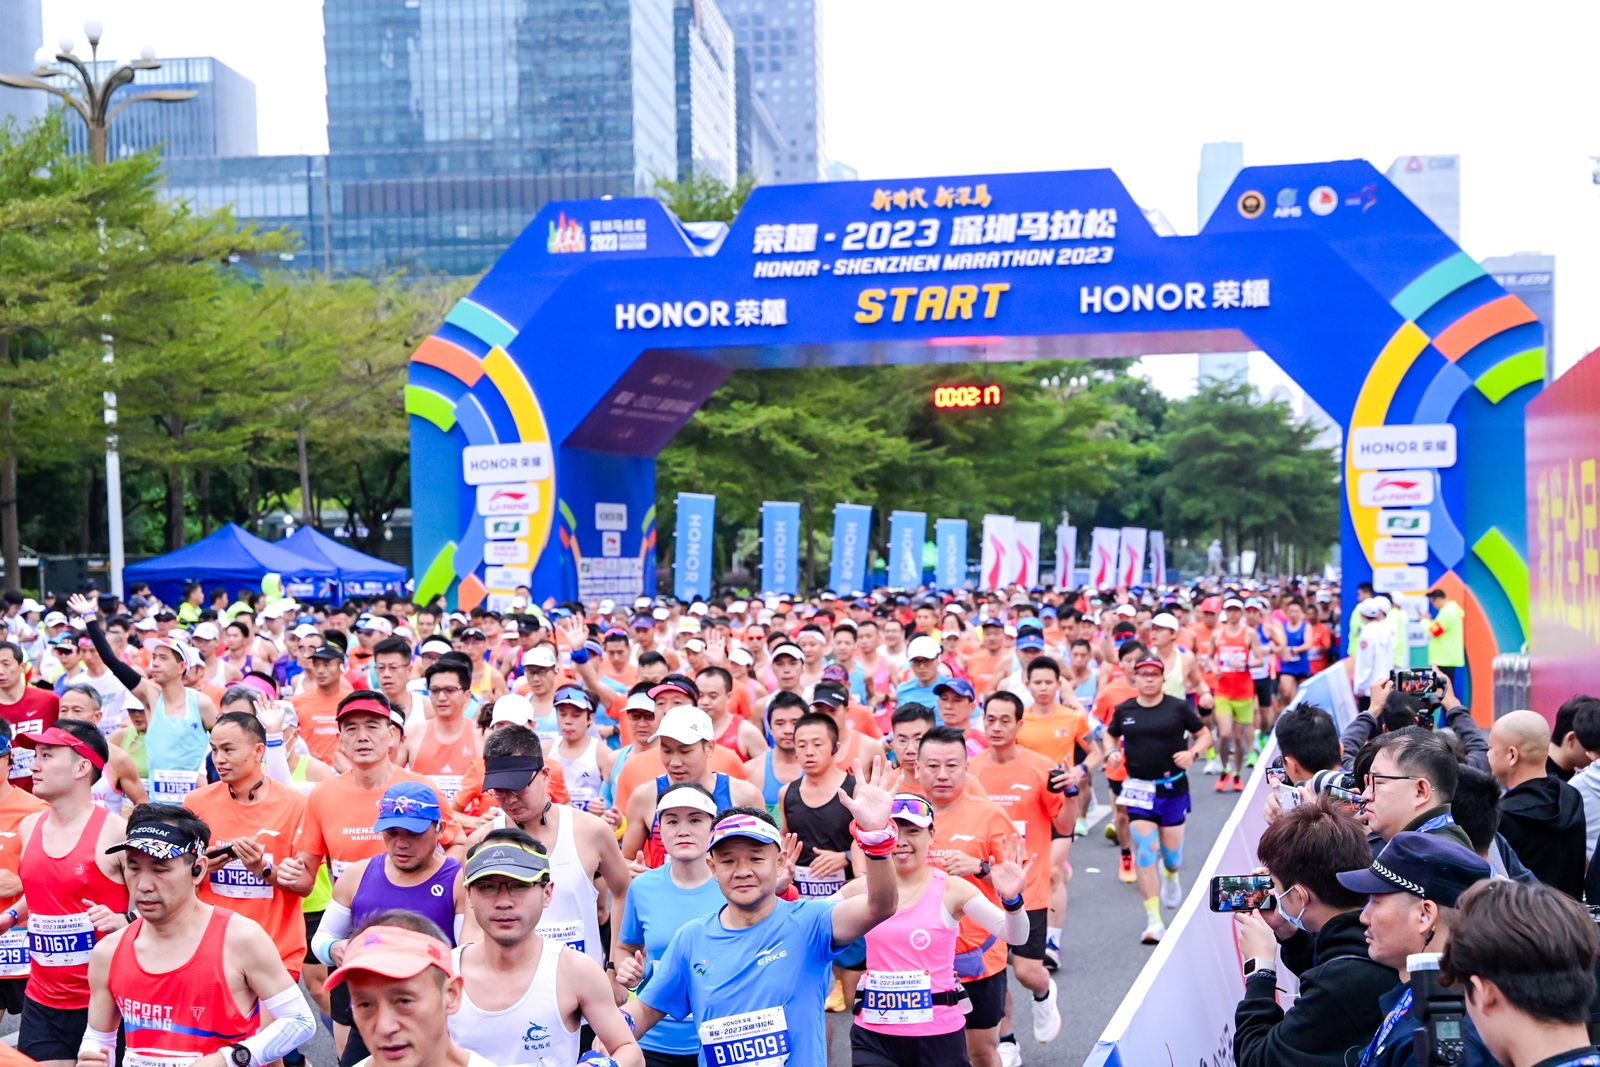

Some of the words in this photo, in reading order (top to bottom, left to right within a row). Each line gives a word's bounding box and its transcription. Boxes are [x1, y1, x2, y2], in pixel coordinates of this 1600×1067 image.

[590, 234, 618, 251] 2023
[752, 223, 819, 254] 荣耀
[842, 219, 941, 251] 2023
[949, 208, 1119, 247] 深圳马拉松
[753, 259, 820, 279] HONOR
[833, 253, 941, 277] SHENZHEN
[943, 249, 1055, 273] MARATHON
[1057, 246, 1114, 266] 2023
[854, 283, 1010, 324] START
[1080, 282, 1207, 313] HONOR
[1212, 279, 1271, 310] 荣耀
[615, 301, 730, 330] HONOR
[734, 297, 788, 327] 荣耀
[470, 457, 517, 471] HONOR
[521, 456, 541, 467] 荣耀
[1360, 440, 1418, 455] HONOR
[1423, 439, 1447, 452] 荣耀
[685, 514, 702, 583] HONOR
[773, 521, 787, 585] HONOR
[841, 521, 858, 586] HONOR
[945, 534, 958, 586] HONOR
[757, 950, 788, 966] ERKE
[124, 998, 173, 1019] SPORT
[724, 1026, 742, 1035] 2023
